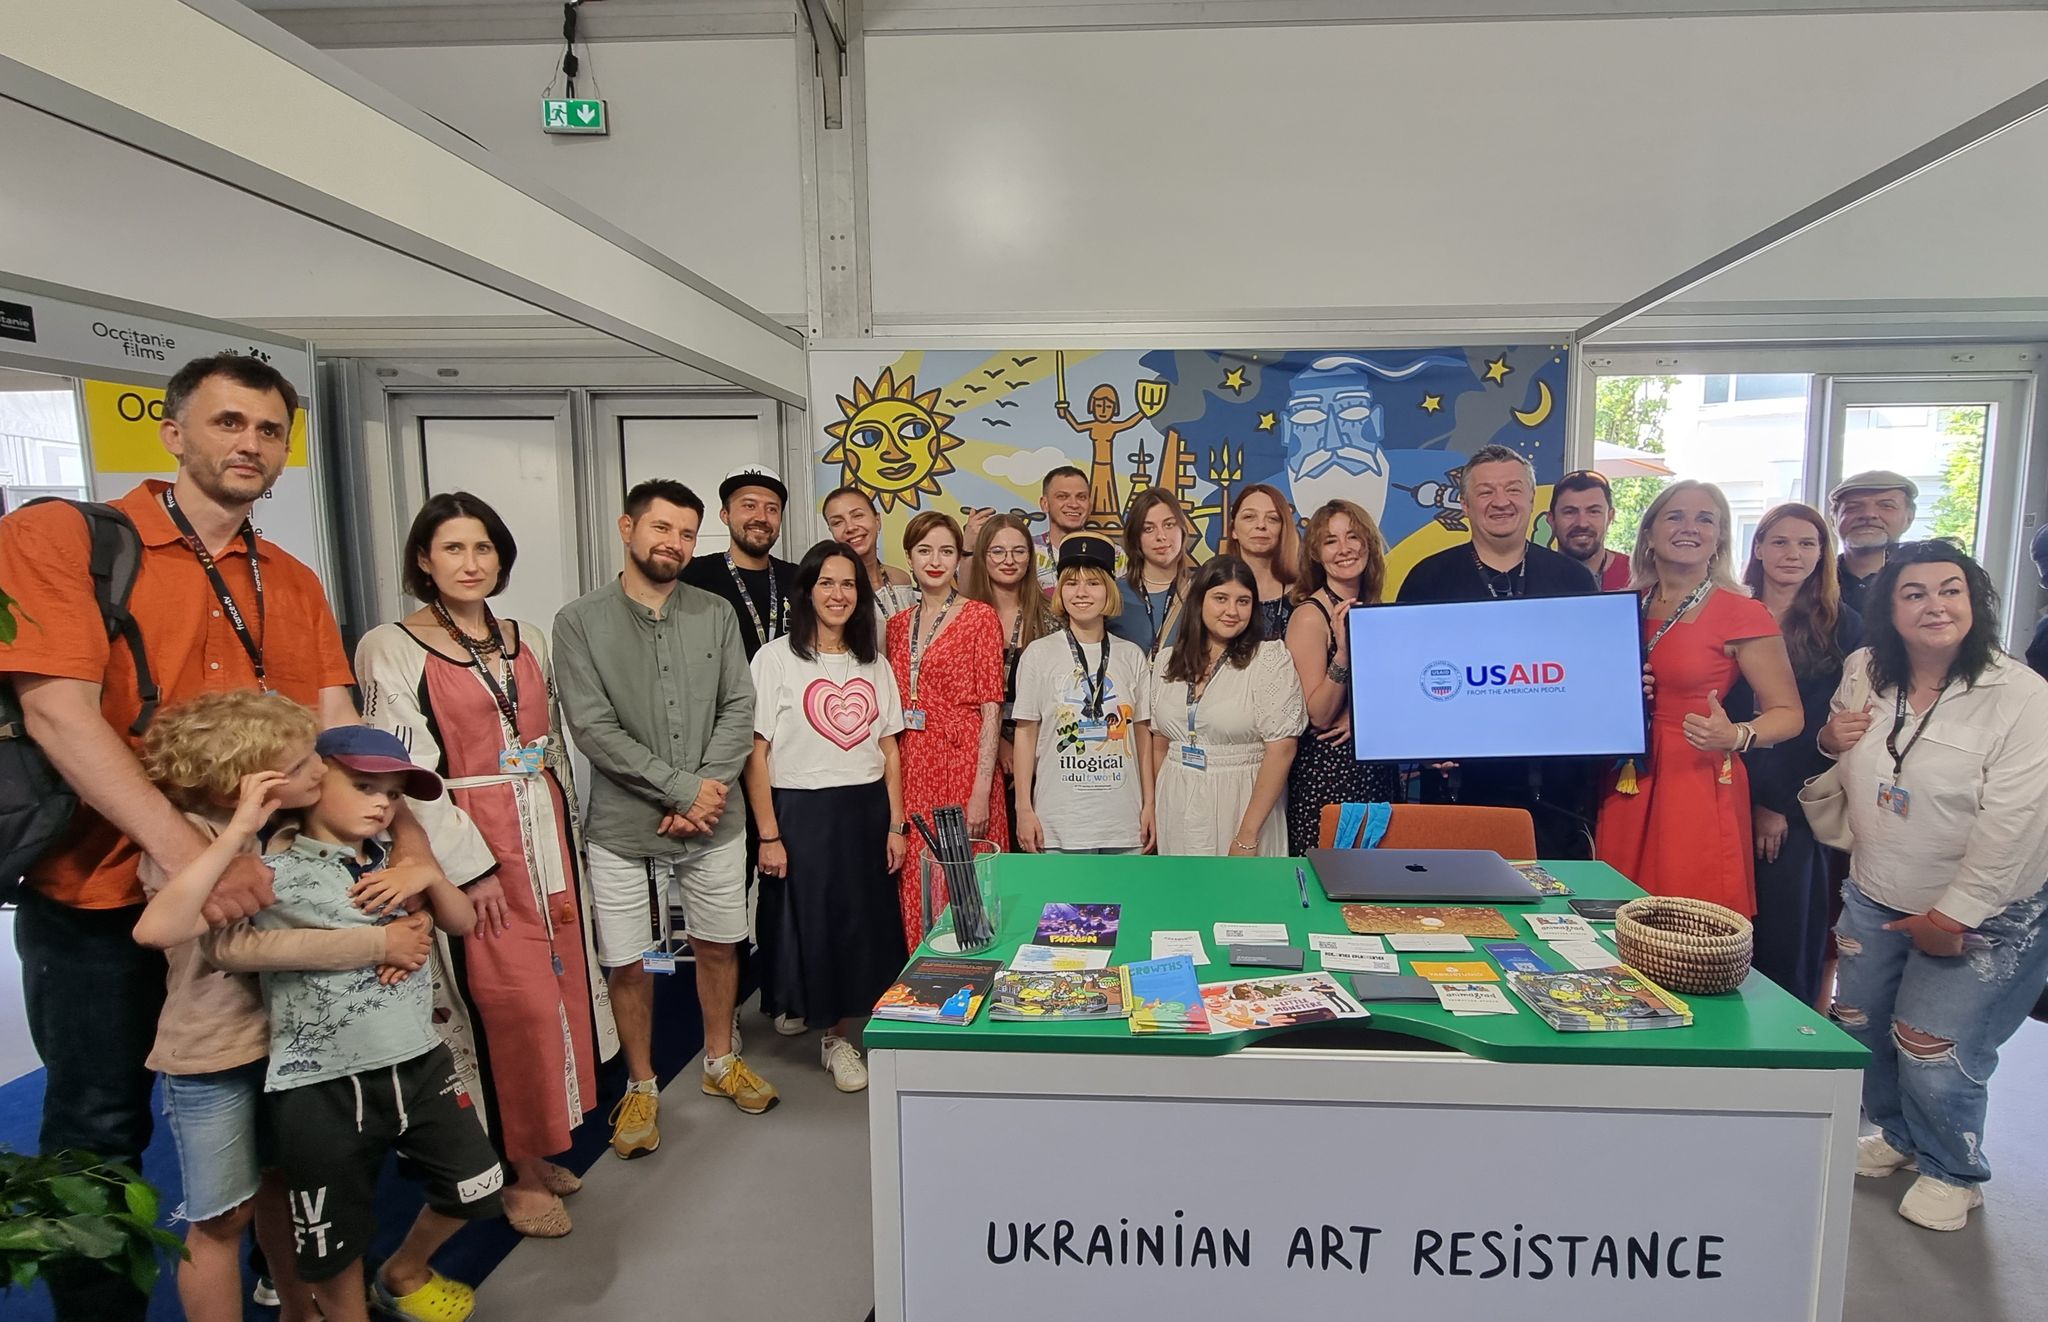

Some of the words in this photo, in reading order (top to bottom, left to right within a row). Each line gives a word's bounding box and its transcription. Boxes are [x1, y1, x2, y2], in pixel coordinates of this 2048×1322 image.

[92, 322, 176, 349] Occitanie
[123, 341, 165, 361] films
[1466, 662, 1565, 687] USAID
[1503, 687, 1540, 695] AMERICAN
[1541, 686, 1566, 694] PEOPLE
[1060, 755, 1123, 773] illogical
[1062, 772, 1092, 782] adult
[1286, 1224, 1383, 1275] ART
